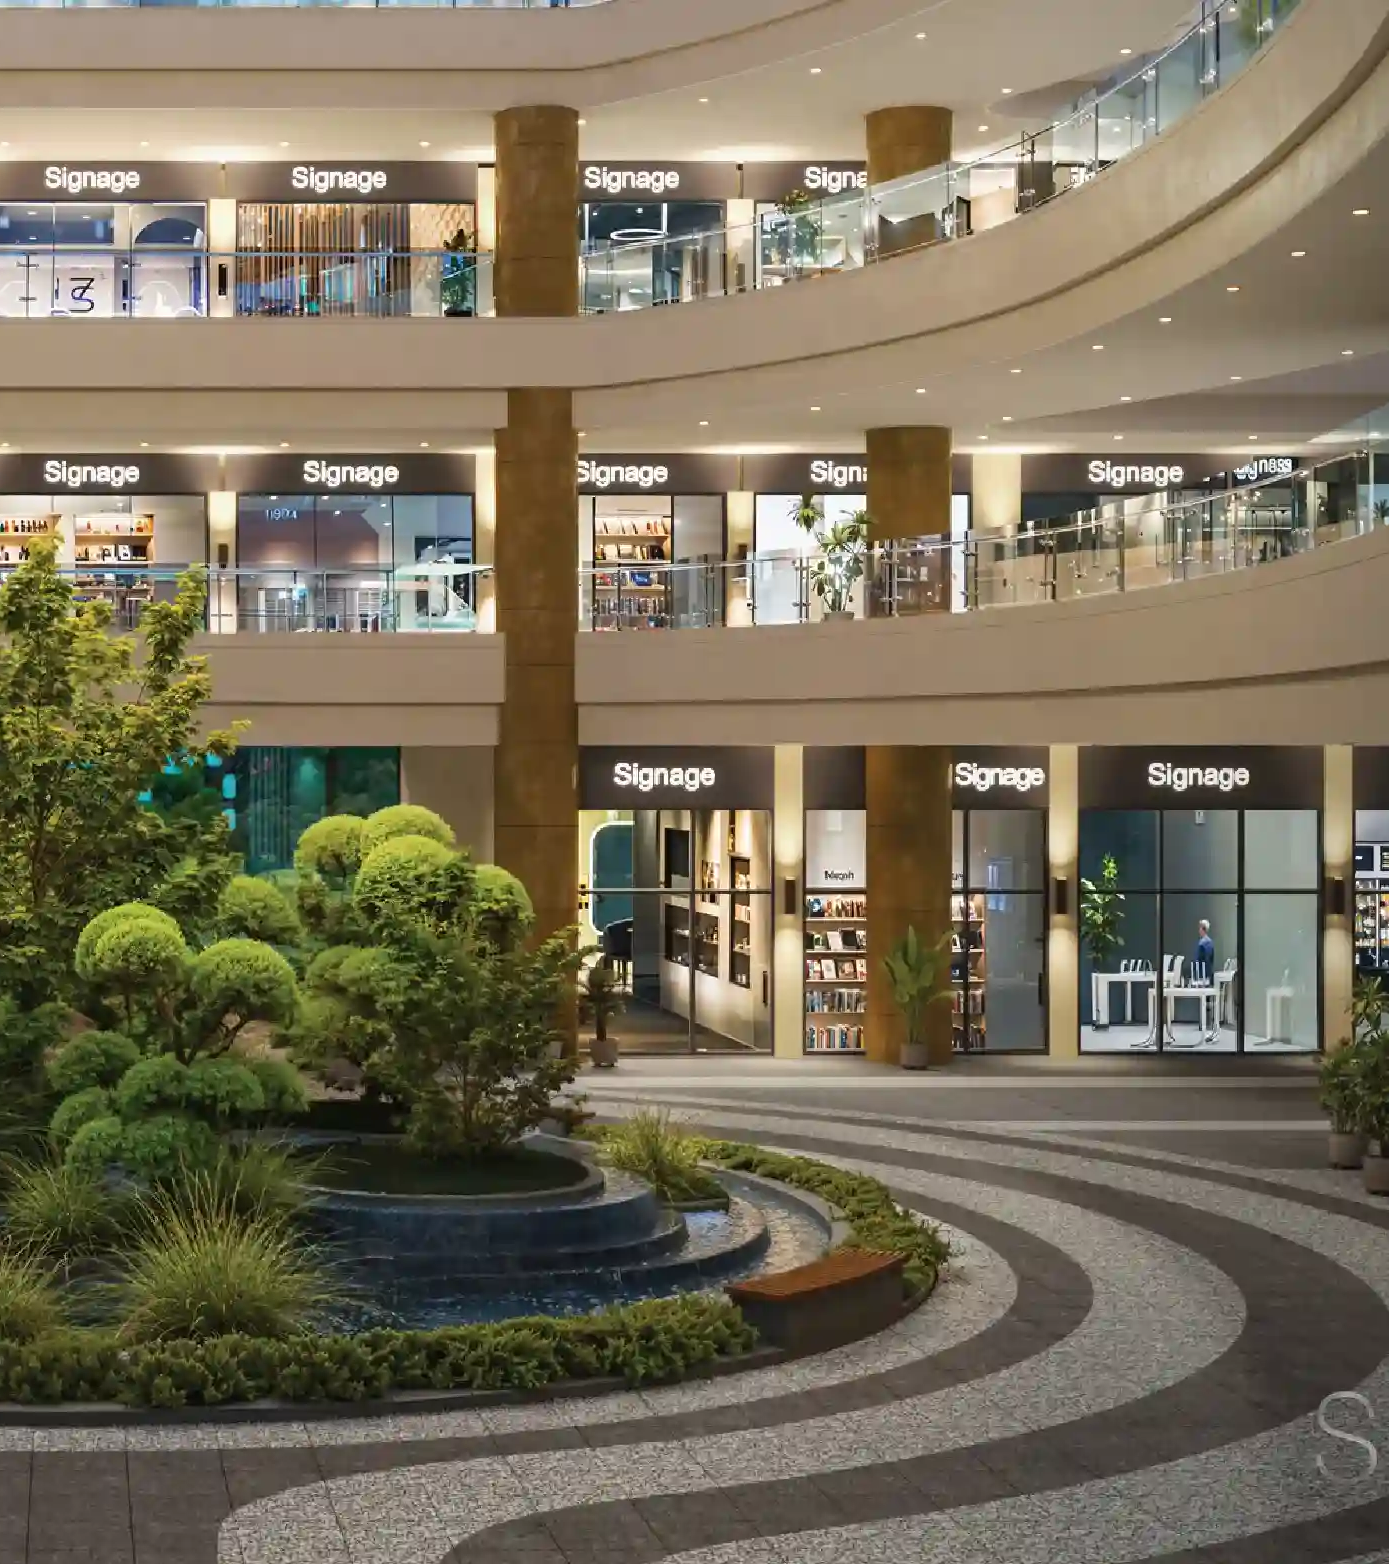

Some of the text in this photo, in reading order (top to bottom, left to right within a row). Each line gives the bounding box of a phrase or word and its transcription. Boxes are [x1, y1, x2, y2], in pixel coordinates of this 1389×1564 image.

[45, 167, 140, 193] Signage
[292, 167, 387, 193] Signage
[584, 167, 679, 193] Signage
[804, 167, 867, 193] Signa
[44, 460, 139, 487] Signage
[304, 460, 399, 487] Signage
[577, 460, 668, 487] Signage
[810, 460, 868, 487] Sign
[1088, 460, 1184, 487] Signage
[614, 763, 716, 791] Signage
[956, 763, 1046, 791] Signage
[1148, 763, 1250, 791] Signage
